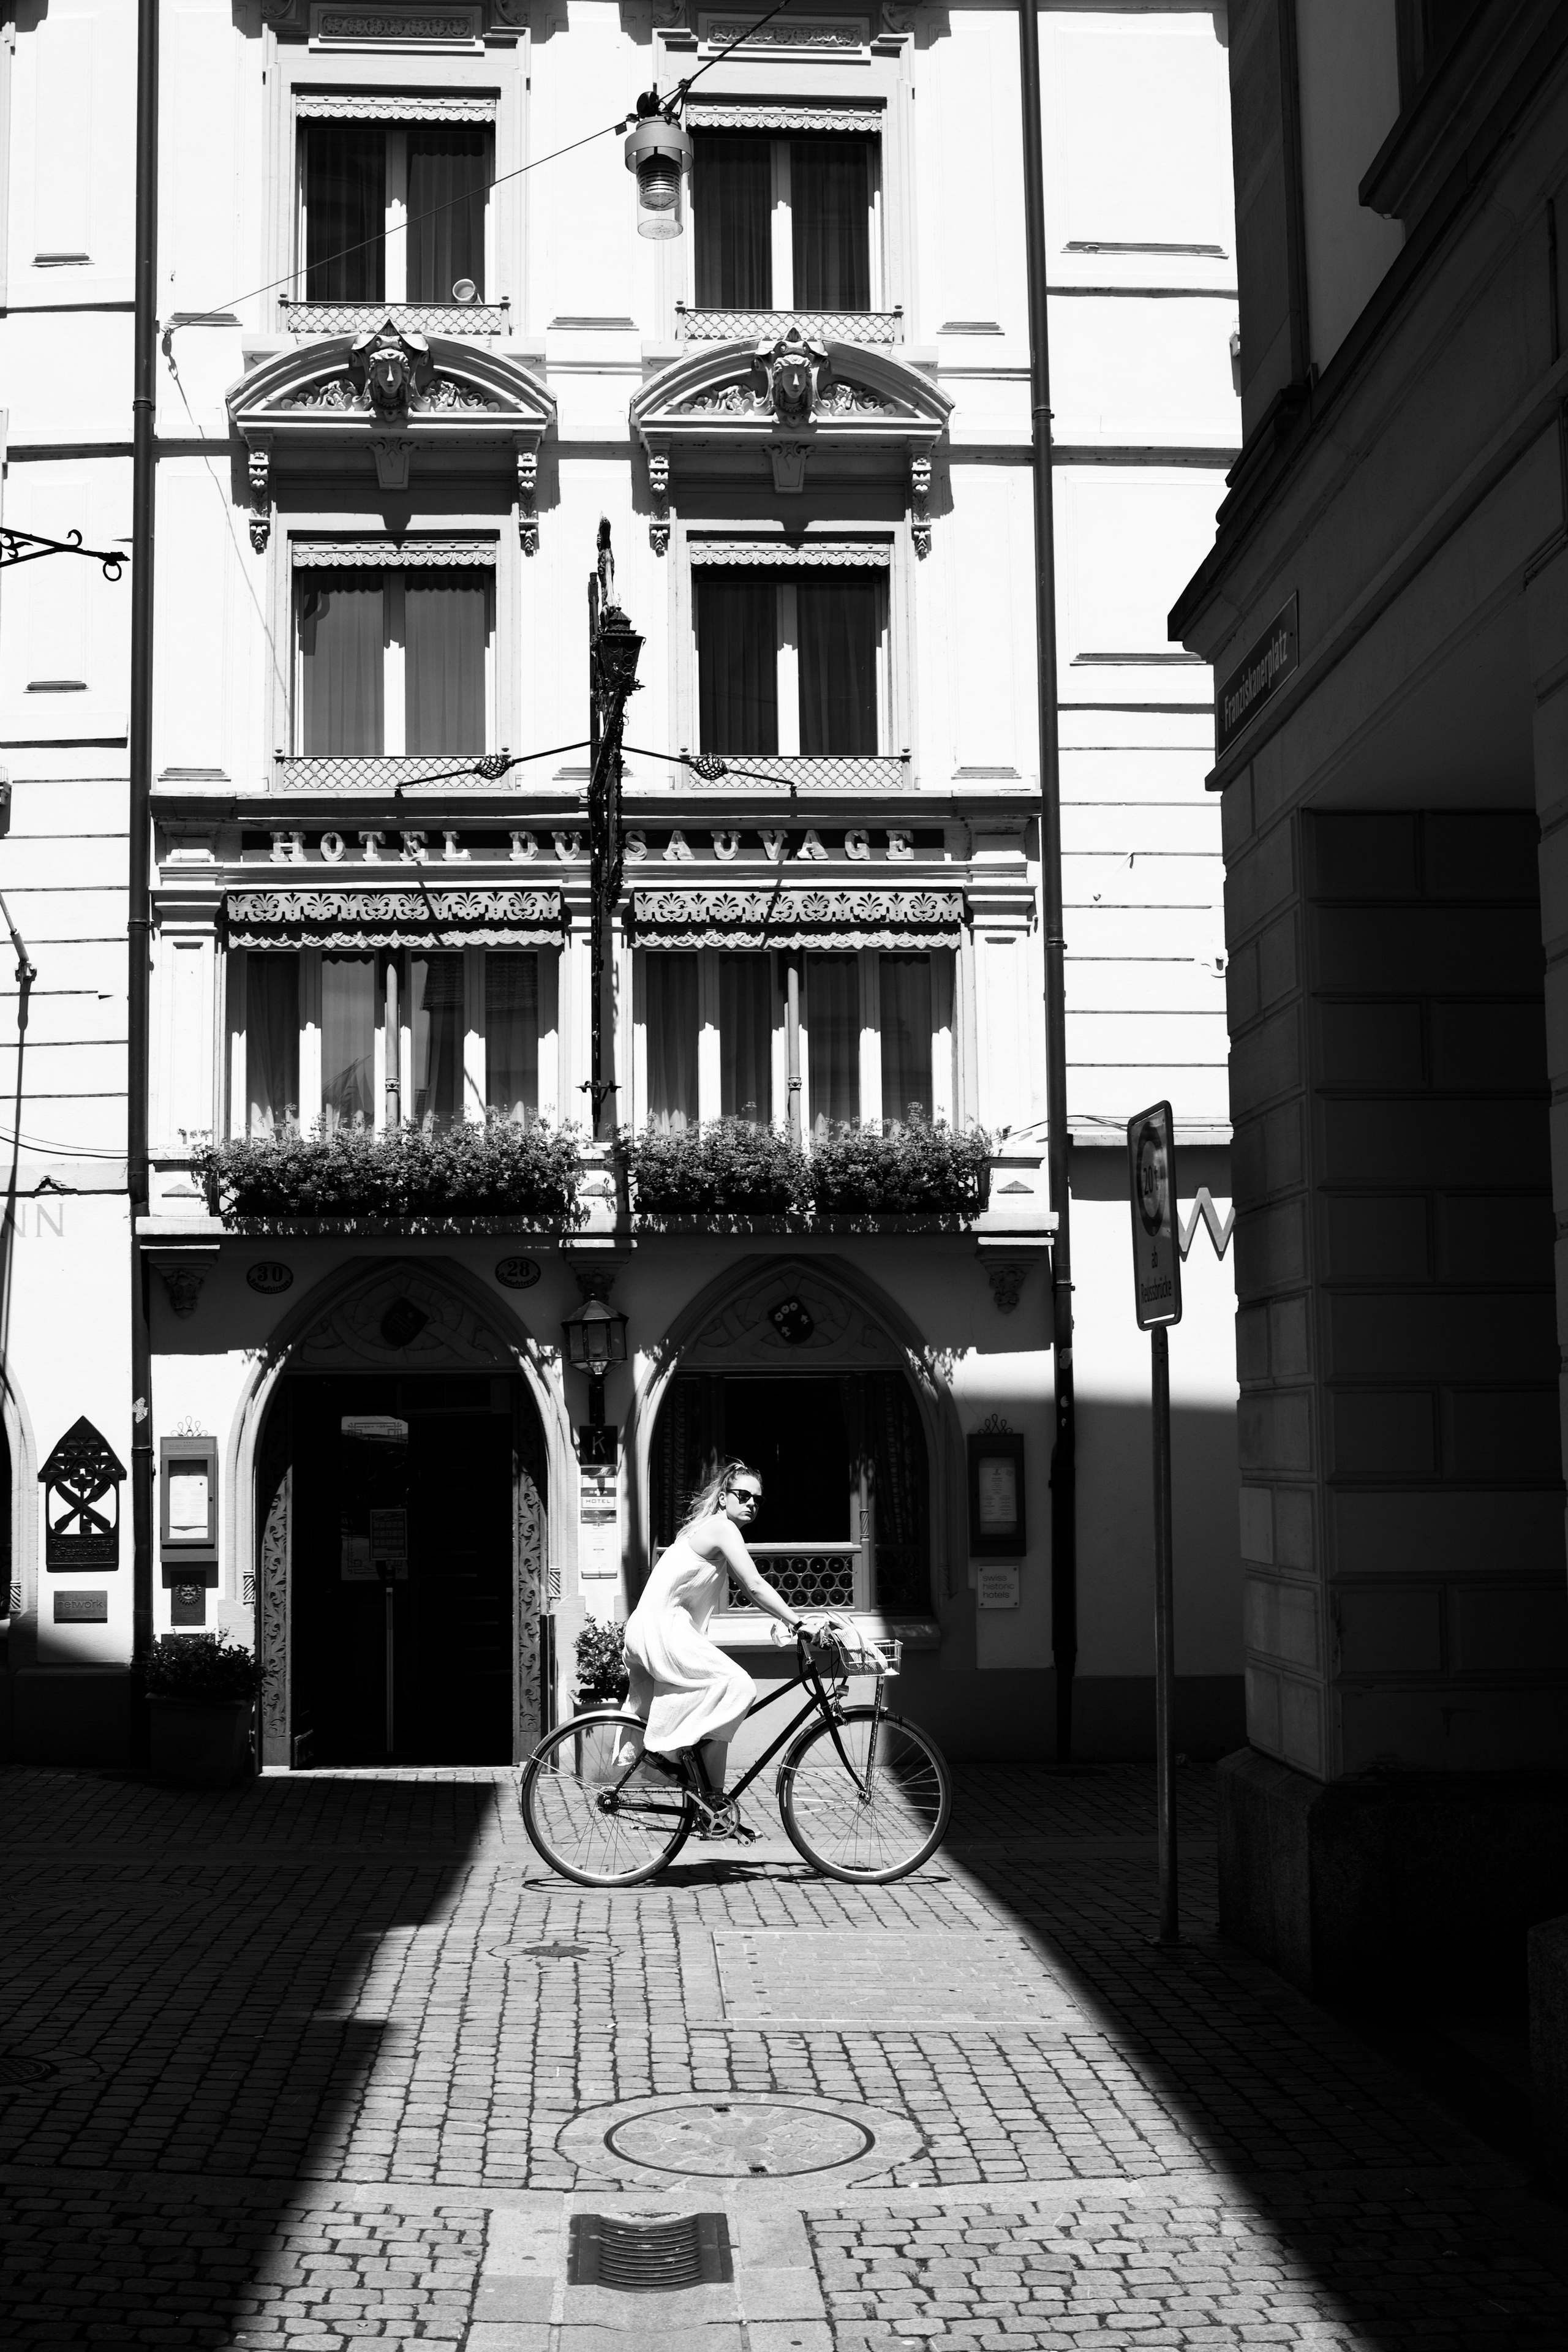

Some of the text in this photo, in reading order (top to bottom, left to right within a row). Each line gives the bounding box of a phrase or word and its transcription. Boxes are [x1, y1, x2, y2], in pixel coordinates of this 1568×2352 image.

[1224, 630, 1287, 732] Franziskanerplatz
[270, 829, 914, 862] HOTEL DU SAUVAGE
[1143, 1165, 1153, 1195] 20
[1151, 1245, 1158, 1268] ab
[257, 1265, 282, 1282] 30
[507, 1261, 530, 1277] 28
[250, 1278, 290, 1291] Bahnhofstrasse
[498, 1273, 537, 1286] Bahnhofstrasse
[1140, 1275, 1172, 1304] Reussbrücke
[592, 1436, 606, 1455] K
[51, 1538, 115, 1548] ROMANTIK HOTELS
[56, 1599, 104, 1609] network
